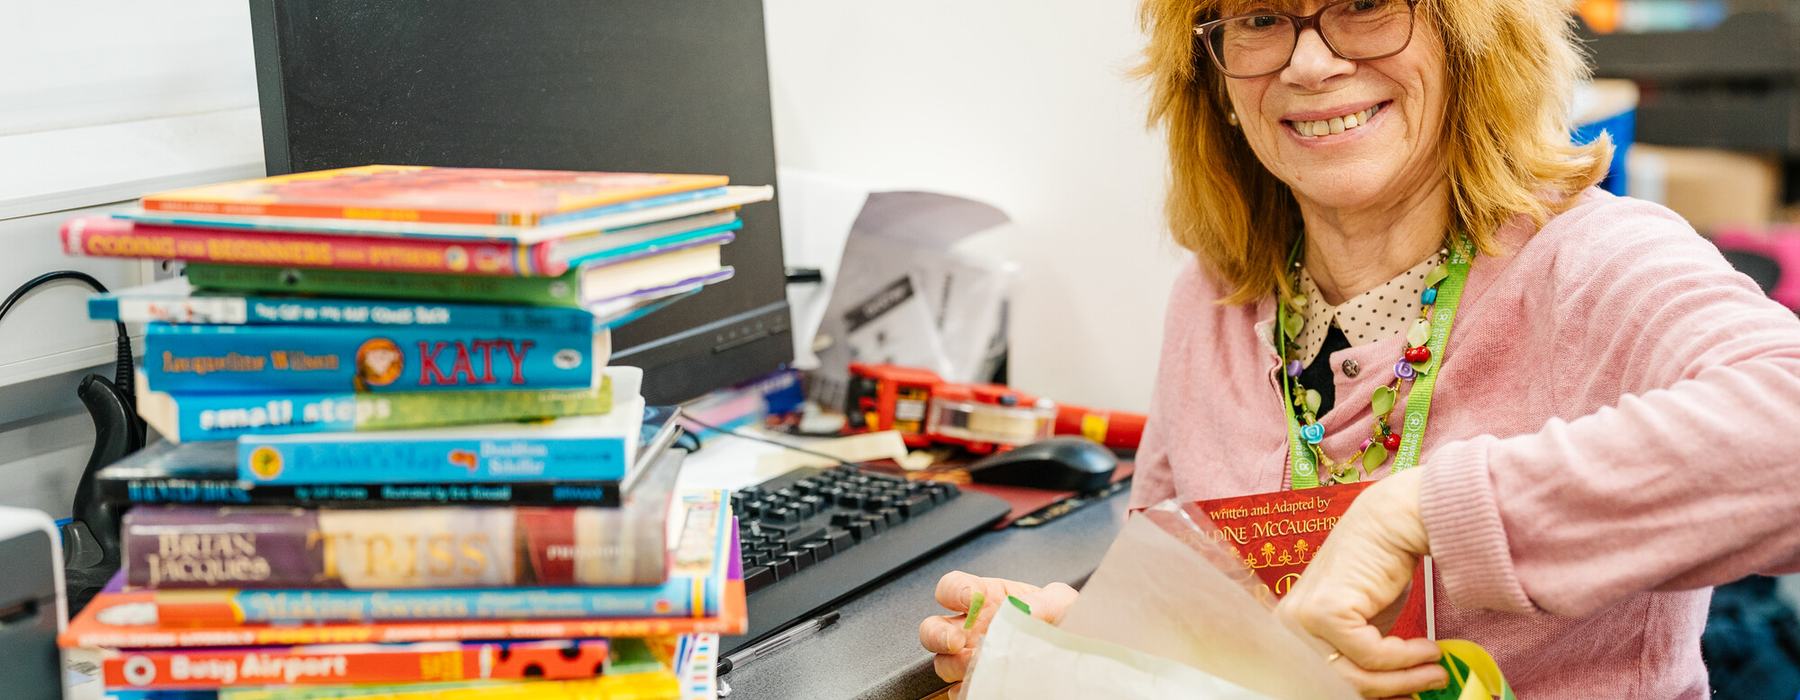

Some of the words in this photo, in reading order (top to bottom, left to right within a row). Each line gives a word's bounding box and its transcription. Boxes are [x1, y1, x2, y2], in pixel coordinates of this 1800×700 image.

[417, 340, 536, 385] KATY
[200, 399, 293, 430] small
[303, 398, 391, 426] steps
[1209, 505, 1249, 521] Written
[1250, 505, 1270, 516] and
[1271, 498, 1315, 515] Adapted
[1316, 496, 1332, 513] by
[158, 532, 257, 559] BRIAN
[306, 529, 490, 580] TRISS
[170, 655, 238, 684] Busy
[240, 652, 348, 683] Airport
